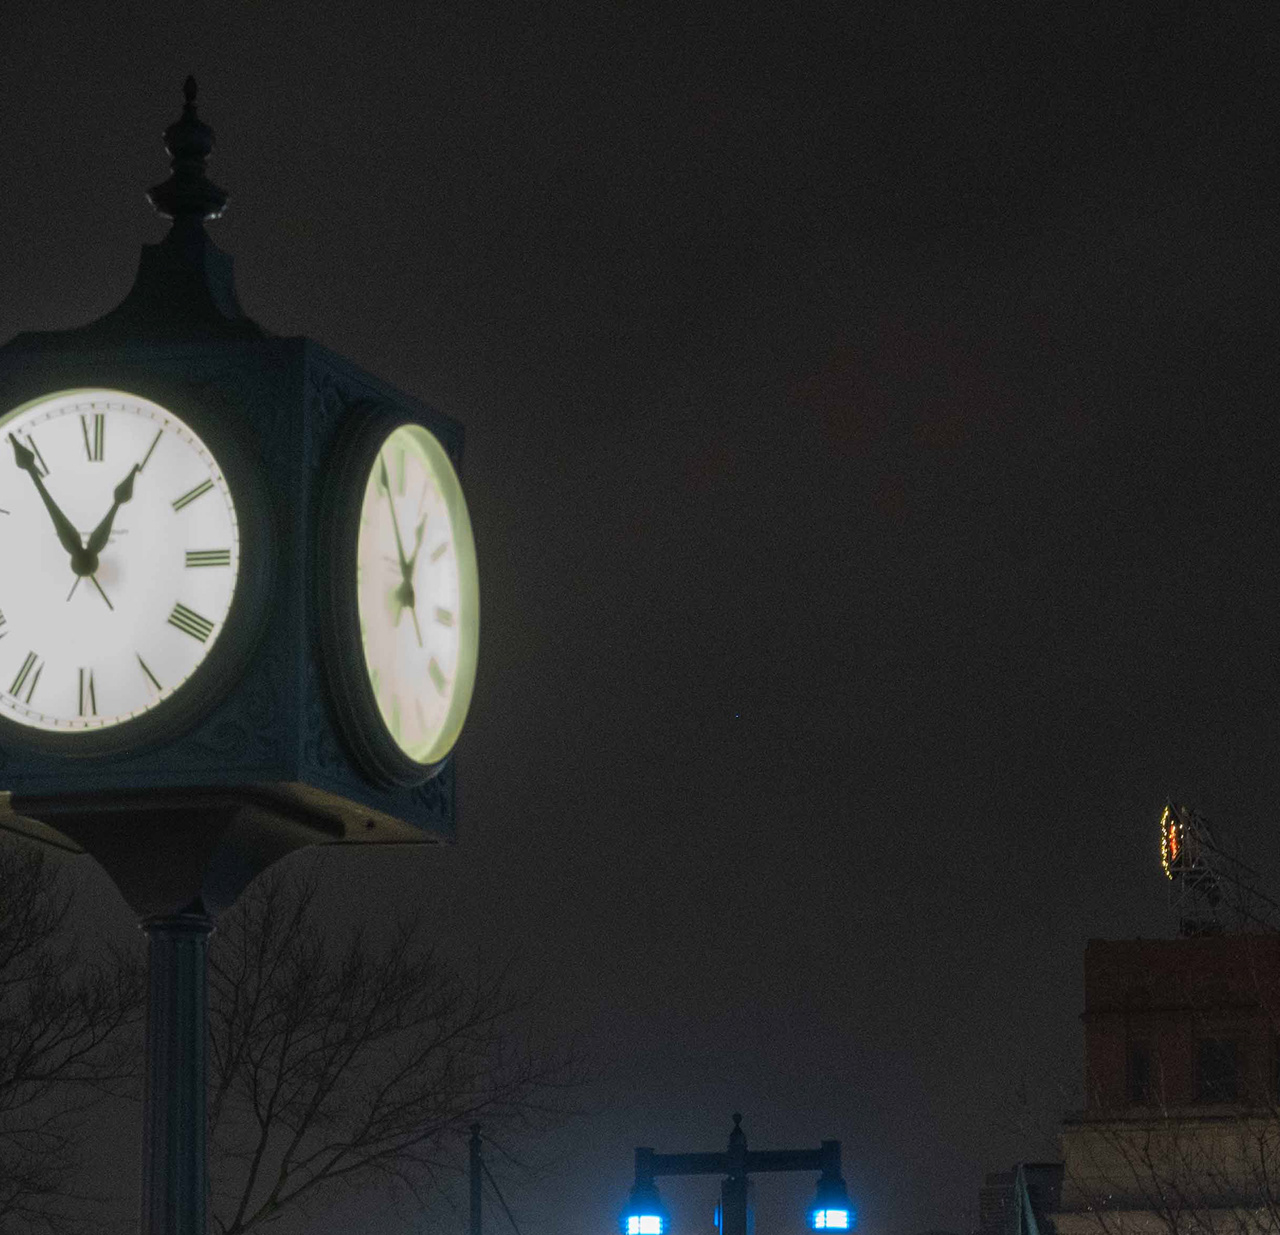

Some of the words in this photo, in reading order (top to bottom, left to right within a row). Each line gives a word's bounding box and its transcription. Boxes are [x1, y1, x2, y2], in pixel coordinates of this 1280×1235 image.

[80, 413, 105, 462] XII
[171, 477, 215, 514] II
[185, 548, 231, 569] III
